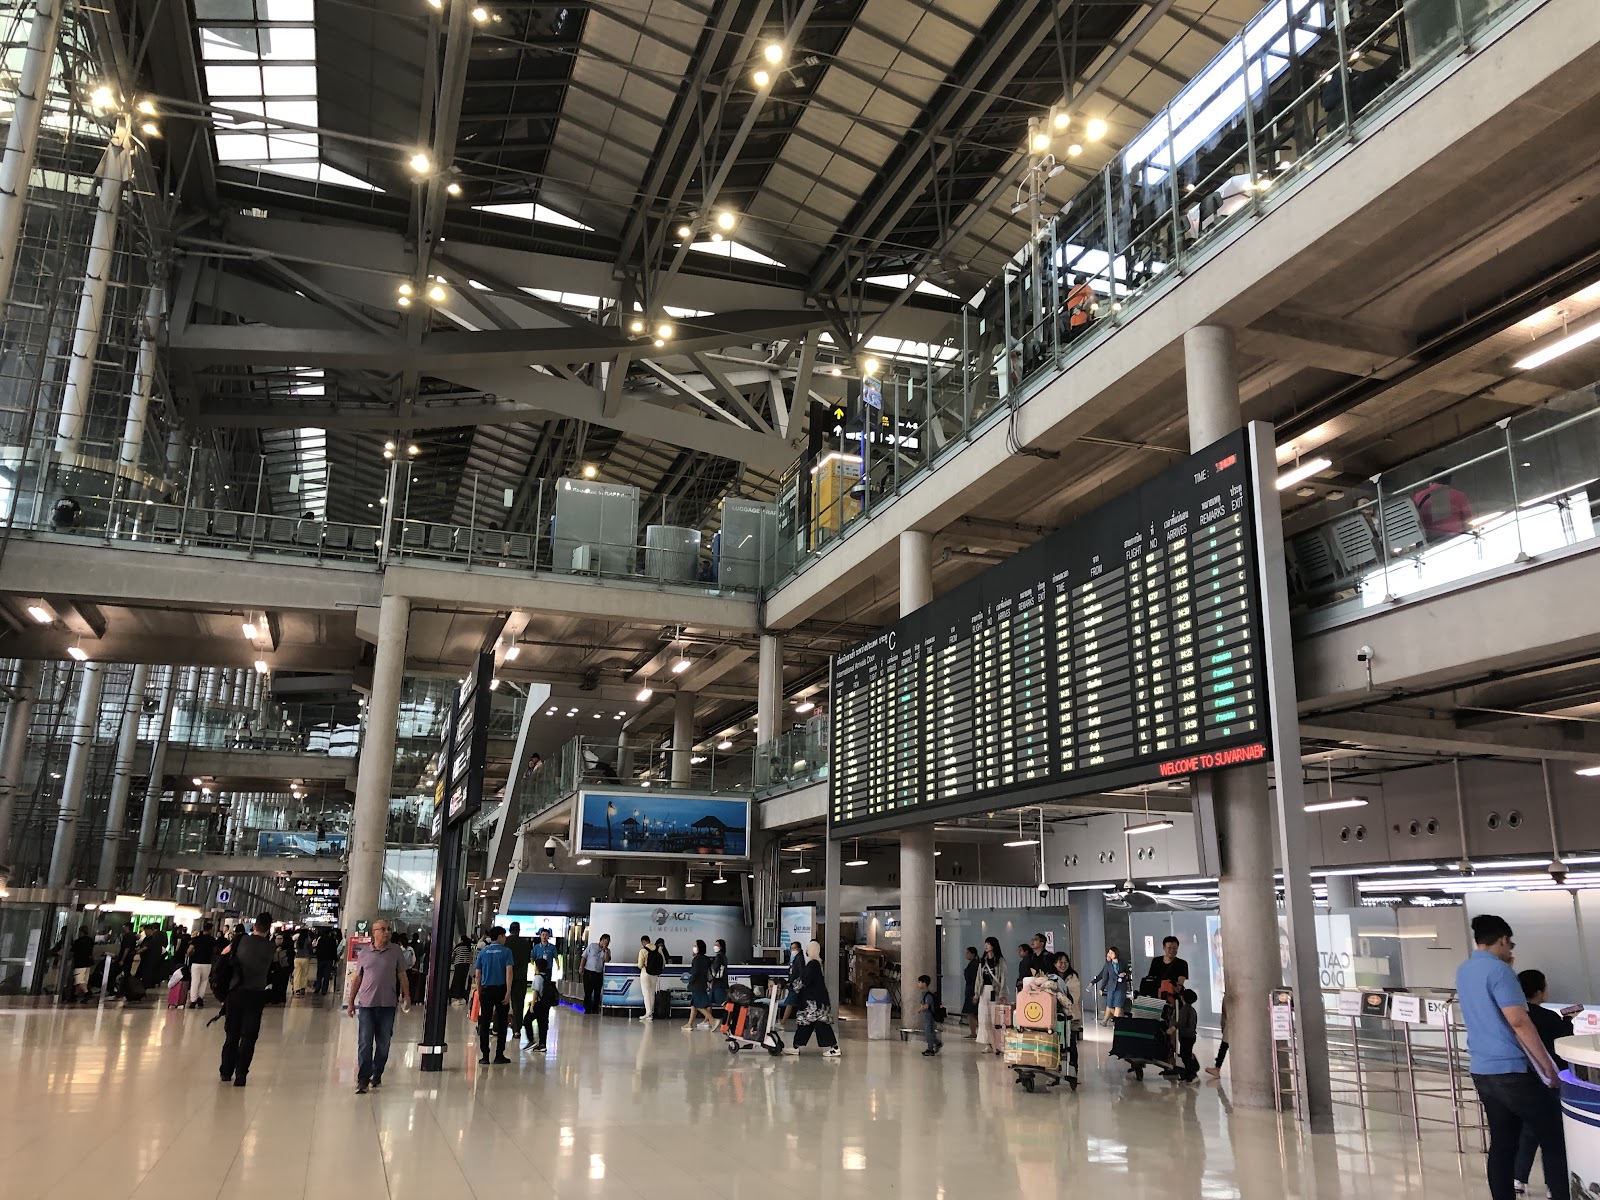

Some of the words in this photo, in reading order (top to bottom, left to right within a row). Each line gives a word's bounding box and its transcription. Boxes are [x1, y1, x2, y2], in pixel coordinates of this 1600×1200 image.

[732, 506, 760, 514] LUGGAGE
[1090, 564, 1102, 578] FROM
[1126, 545, 1142, 561] FLIGHT
[1150, 538, 1158, 550] NO
[1166, 524, 1187, 542] ARRIVES
[1200, 505, 1225, 526] REMARKS
[1232, 496, 1244, 511] EXIT
[888, 631, 896, 650] C
[836, 664, 854, 679] International
[855, 658, 866, 670] Arrivals
[866, 654, 876, 664] Door
[1160, 757, 1198, 776] WELCOME
[1200, 752, 1214, 768] TO
